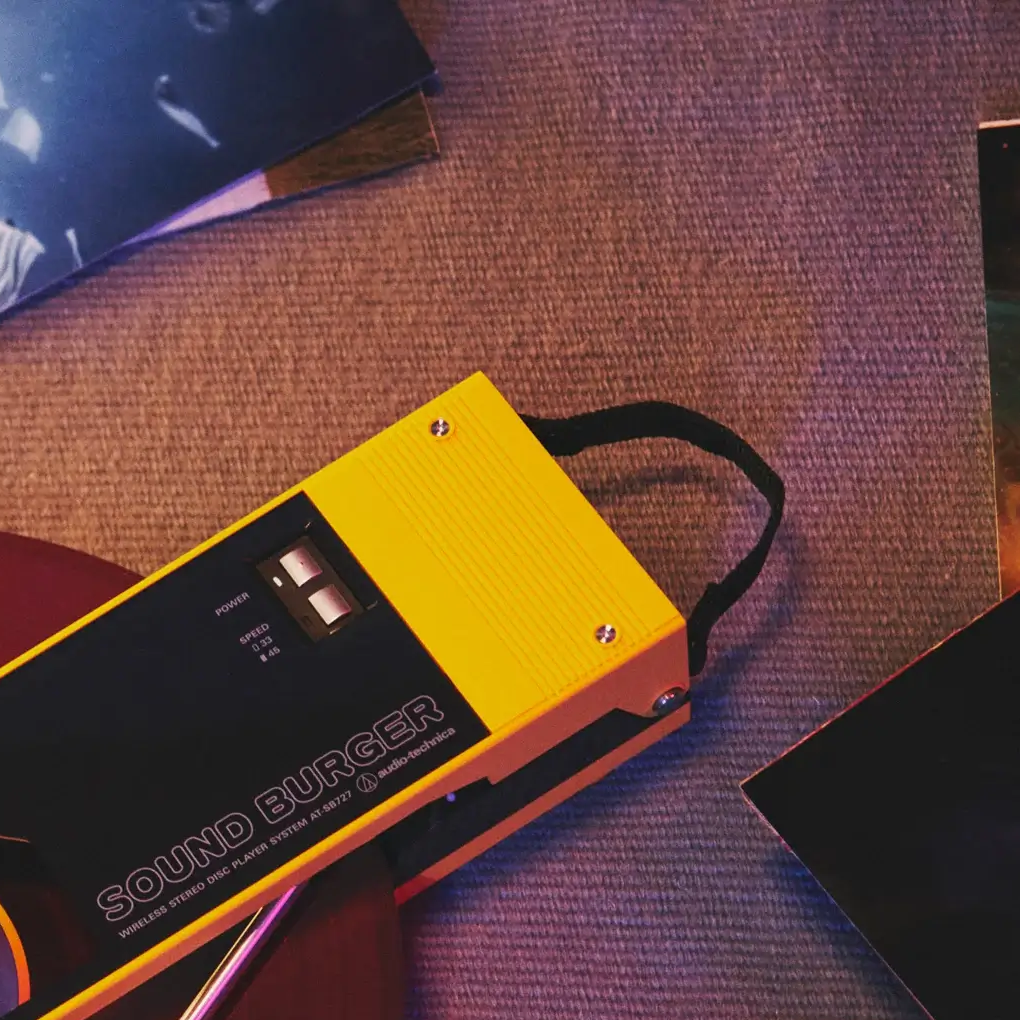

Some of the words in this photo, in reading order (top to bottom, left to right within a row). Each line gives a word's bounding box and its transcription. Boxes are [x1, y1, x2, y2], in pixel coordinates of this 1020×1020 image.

[214, 591, 251, 617] POWER
[239, 622, 270, 645] SPEED
[259, 635, 274, 649] 33
[267, 646, 281, 659] 45
[377, 727, 457, 779] audio-technica
[97, 812, 254, 922] SOUND
[254, 695, 445, 825] BURGER
[118, 905, 168, 939] WIRELESS
[168, 881, 206, 908] STEREO
[206, 866, 231, 885] DISC
[231, 842, 269, 869] PLAYER
[269, 817, 309, 846] SYSTEM
[310, 789, 353, 822] AT-SB727
